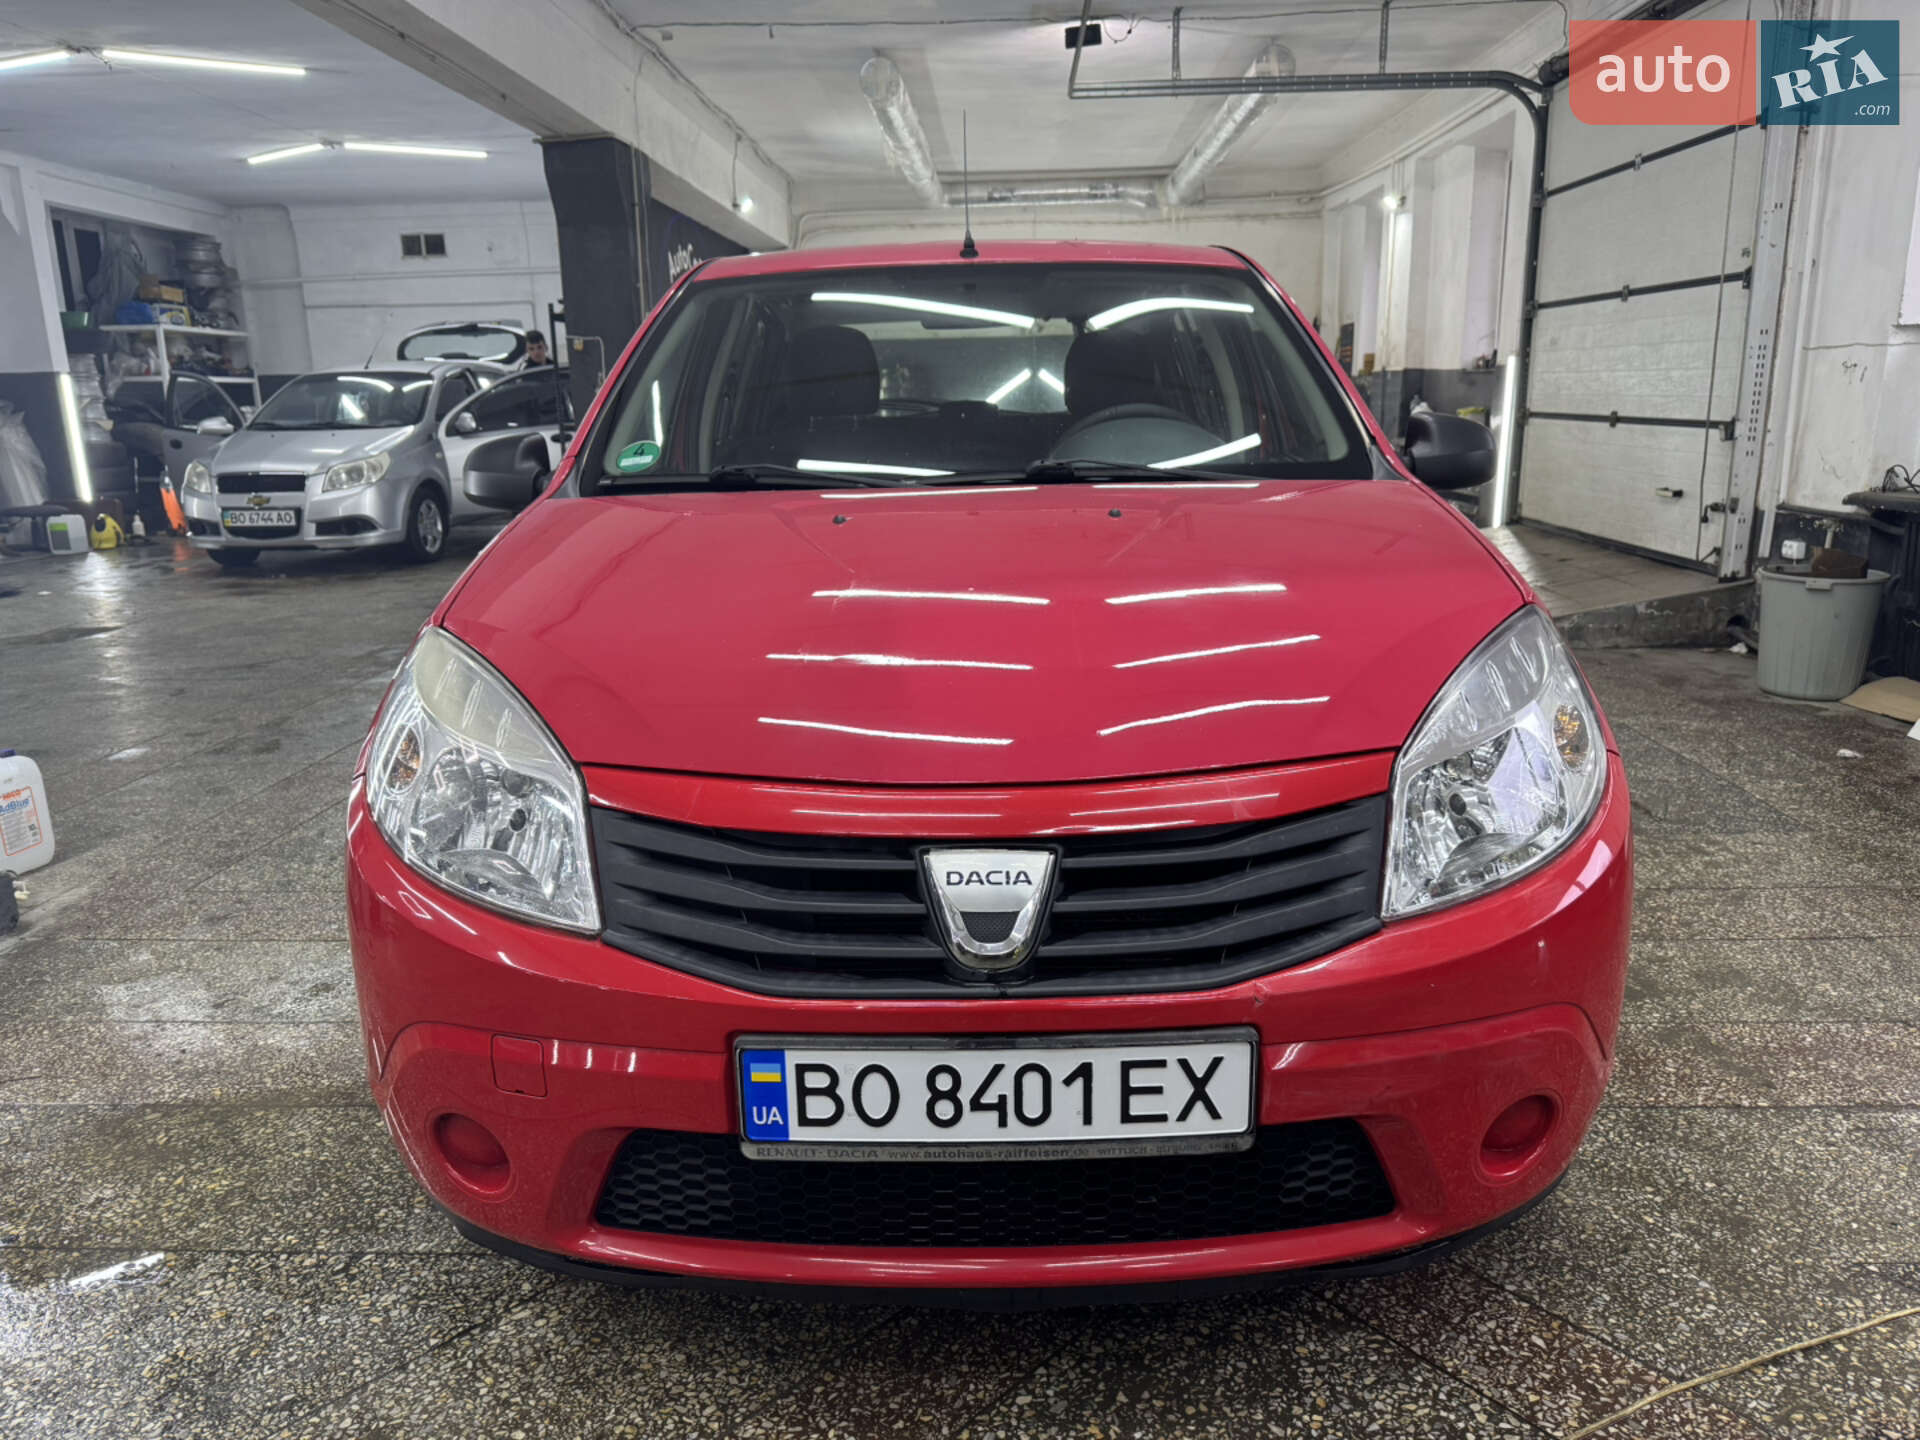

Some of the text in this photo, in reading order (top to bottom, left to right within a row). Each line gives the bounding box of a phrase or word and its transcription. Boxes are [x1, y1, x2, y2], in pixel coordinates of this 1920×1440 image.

[633, 443, 645, 456] 4
[232, 511, 293, 524] BO 6744 AO
[946, 870, 1032, 886] DACIA
[795, 1056, 1224, 1128] BO 8401 EX
[752, 1107, 784, 1125] UA
